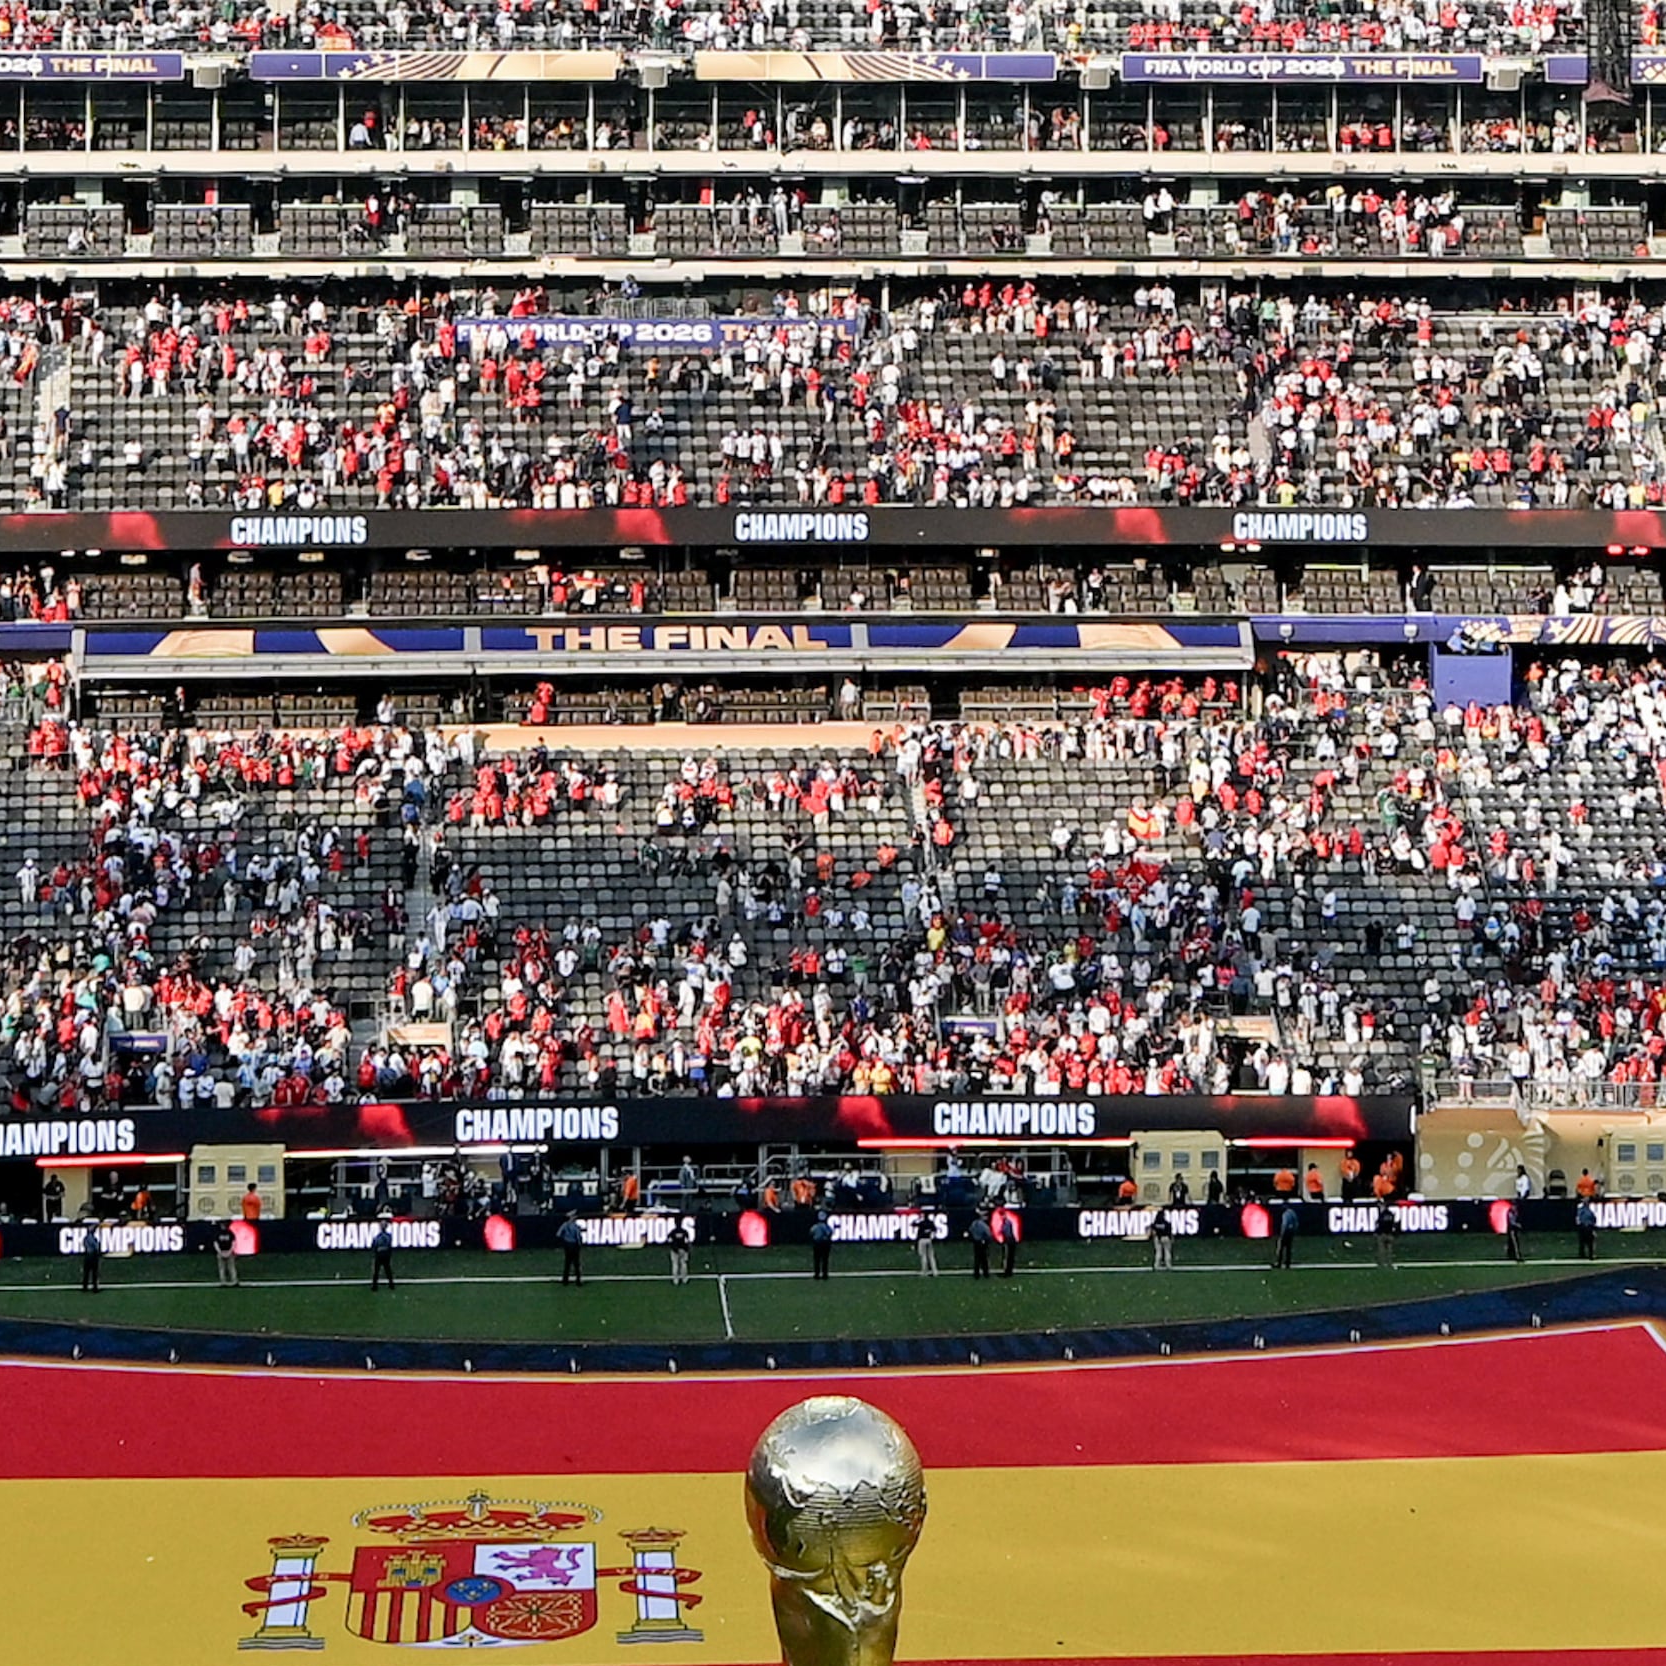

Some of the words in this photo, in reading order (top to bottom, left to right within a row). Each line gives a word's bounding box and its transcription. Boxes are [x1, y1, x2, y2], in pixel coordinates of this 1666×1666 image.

[50, 57, 93, 74] THE
[95, 57, 157, 74] FINAL
[1144, 59, 1181, 76] FIFA
[1184, 59, 1246, 76] WORLD
[1248, 59, 1282, 76] CUP
[1285, 59, 1345, 76] 2026
[1352, 59, 1393, 76] THE
[1395, 59, 1457, 76] FINAL
[636, 324, 712, 342] 2026
[230, 514, 367, 548] CHAMPIONS
[734, 510, 869, 543] CHAMPIONS
[1233, 512, 1367, 543] CHAMPIONS
[525, 625, 642, 651] THE
[654, 625, 827, 651] FINAL
[456, 1106, 618, 1142] CHAMPIONS
[933, 1101, 1095, 1136] CHAMPIONS
